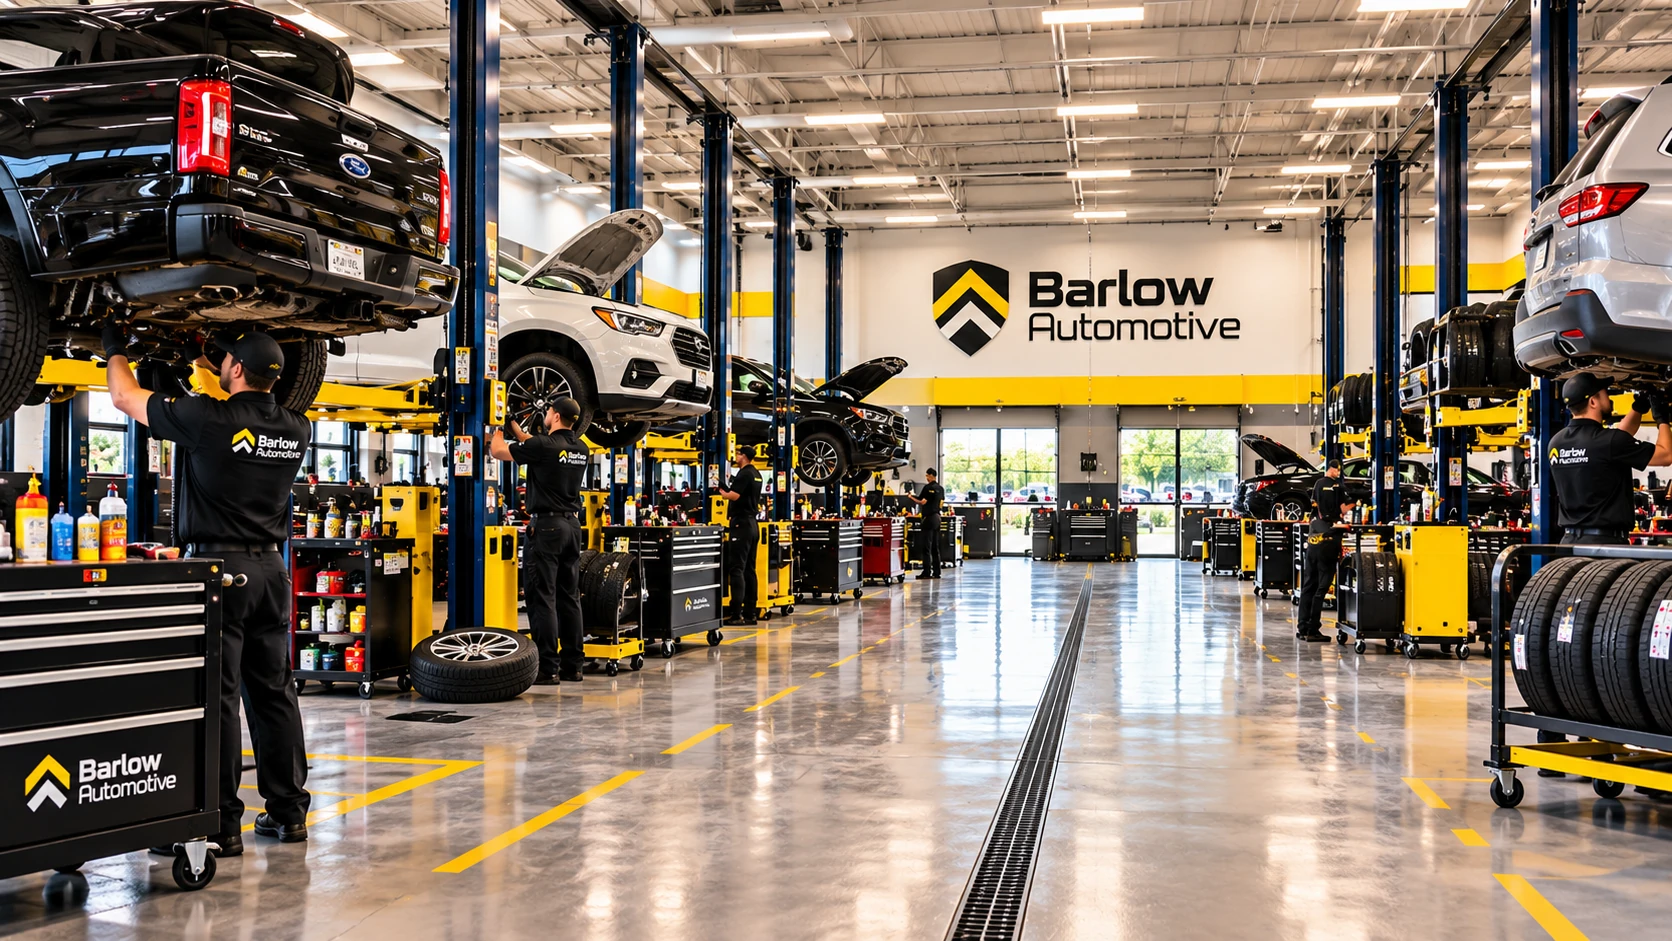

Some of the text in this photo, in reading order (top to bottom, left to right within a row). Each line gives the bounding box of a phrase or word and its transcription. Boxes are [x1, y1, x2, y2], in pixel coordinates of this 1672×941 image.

[1029, 269, 1214, 307] Barlow
[1029, 311, 1241, 341] Automotive
[258, 434, 299, 450] Barlow
[78, 753, 162, 783] Barlow
[78, 773, 177, 805] Automotive
